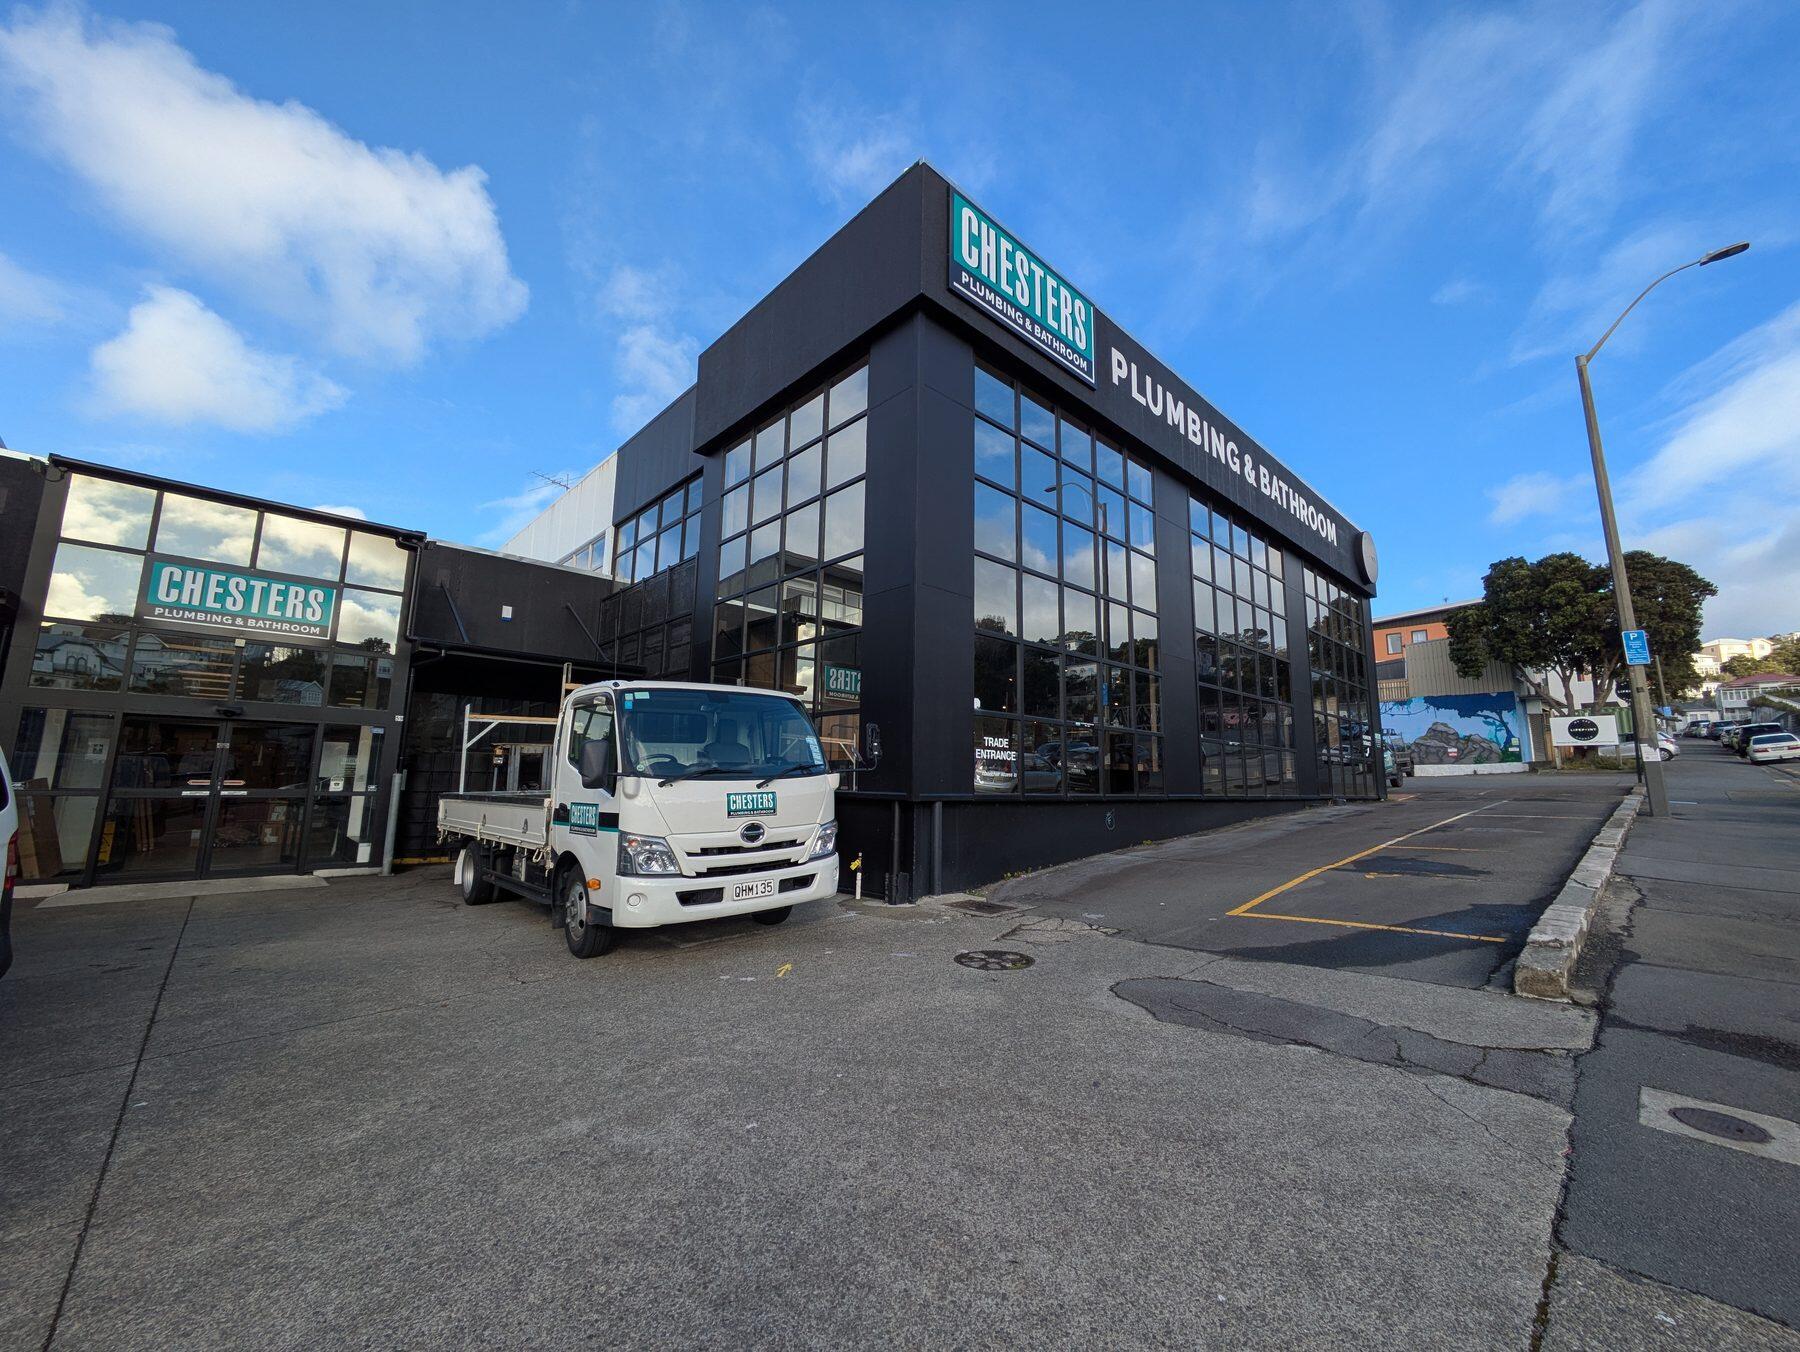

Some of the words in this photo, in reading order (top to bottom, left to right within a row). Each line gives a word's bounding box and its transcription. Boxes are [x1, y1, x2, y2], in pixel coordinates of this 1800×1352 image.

[961, 207, 1087, 350] CHESTERS
[961, 271, 1024, 324] PLUMBING
[1024, 317, 1033, 332] &
[1034, 324, 1088, 372] BATHROOM
[1111, 346, 1241, 474] PLUMBING
[1244, 453, 1258, 488] &
[1259, 464, 1338, 546] BATHROOM
[157, 566, 325, 622] CHESTERS
[154, 607, 233, 624] PLUMBING
[234, 617, 245, 626] &
[247, 618, 321, 635] BATHROOM
[983, 736, 1010, 749] TRADE
[975, 749, 1017, 761] ENTRANCE
[730, 793, 774, 810] CHESTERS
[571, 805, 596, 826] CHESTERS
[734, 881, 774, 898] QHM135
